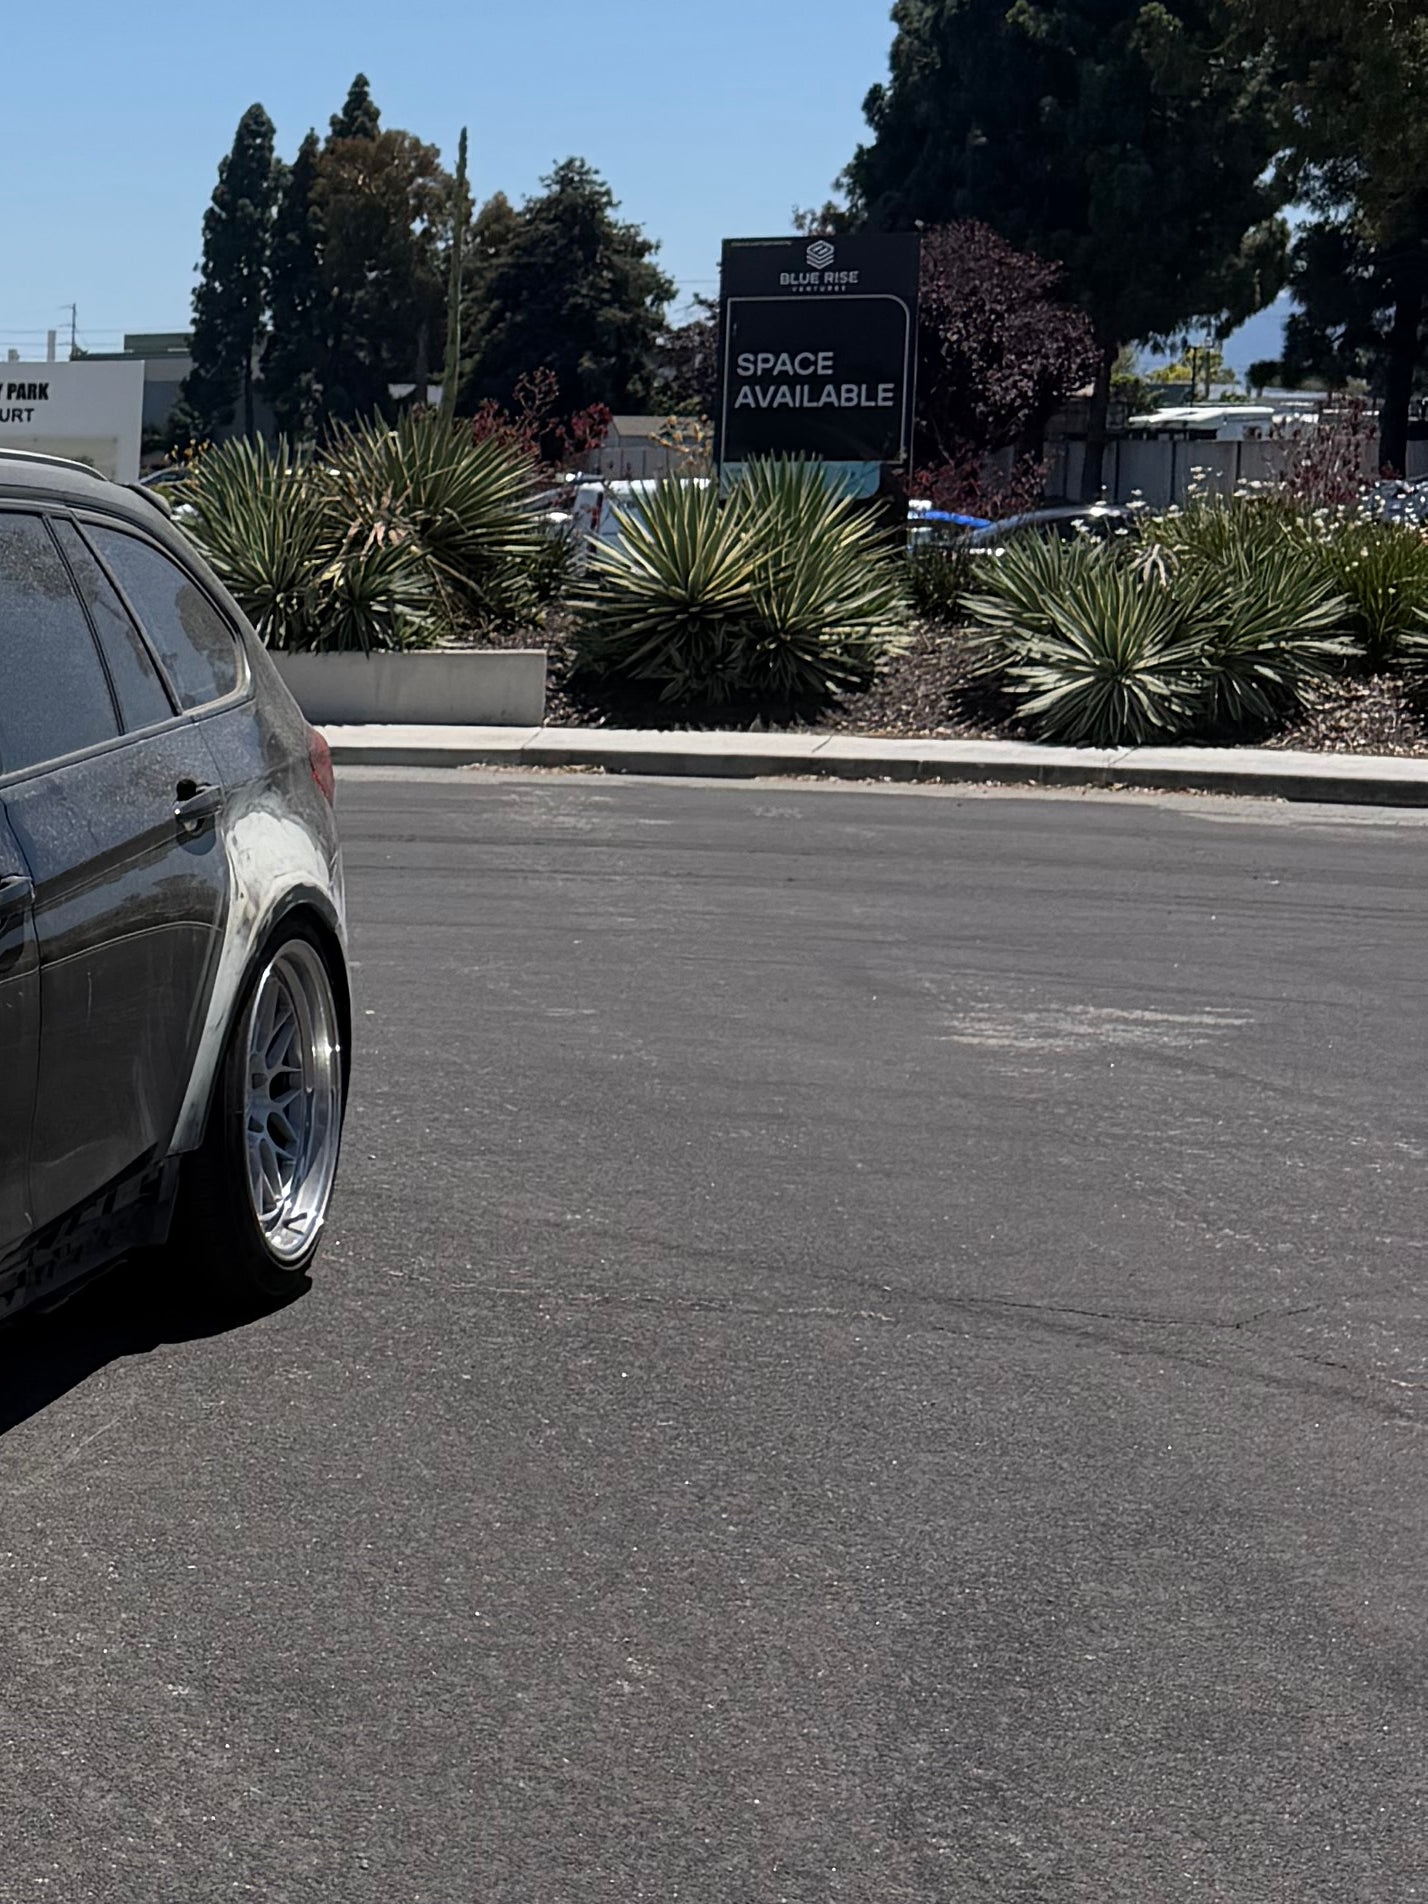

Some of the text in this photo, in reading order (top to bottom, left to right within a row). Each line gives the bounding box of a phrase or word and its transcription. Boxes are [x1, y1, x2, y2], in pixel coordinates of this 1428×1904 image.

[779, 270, 859, 285] BLUE RISE
[736, 352, 834, 377] SPACE
[6, 382, 50, 401] PARK
[734, 383, 895, 409] AVAILABLE
